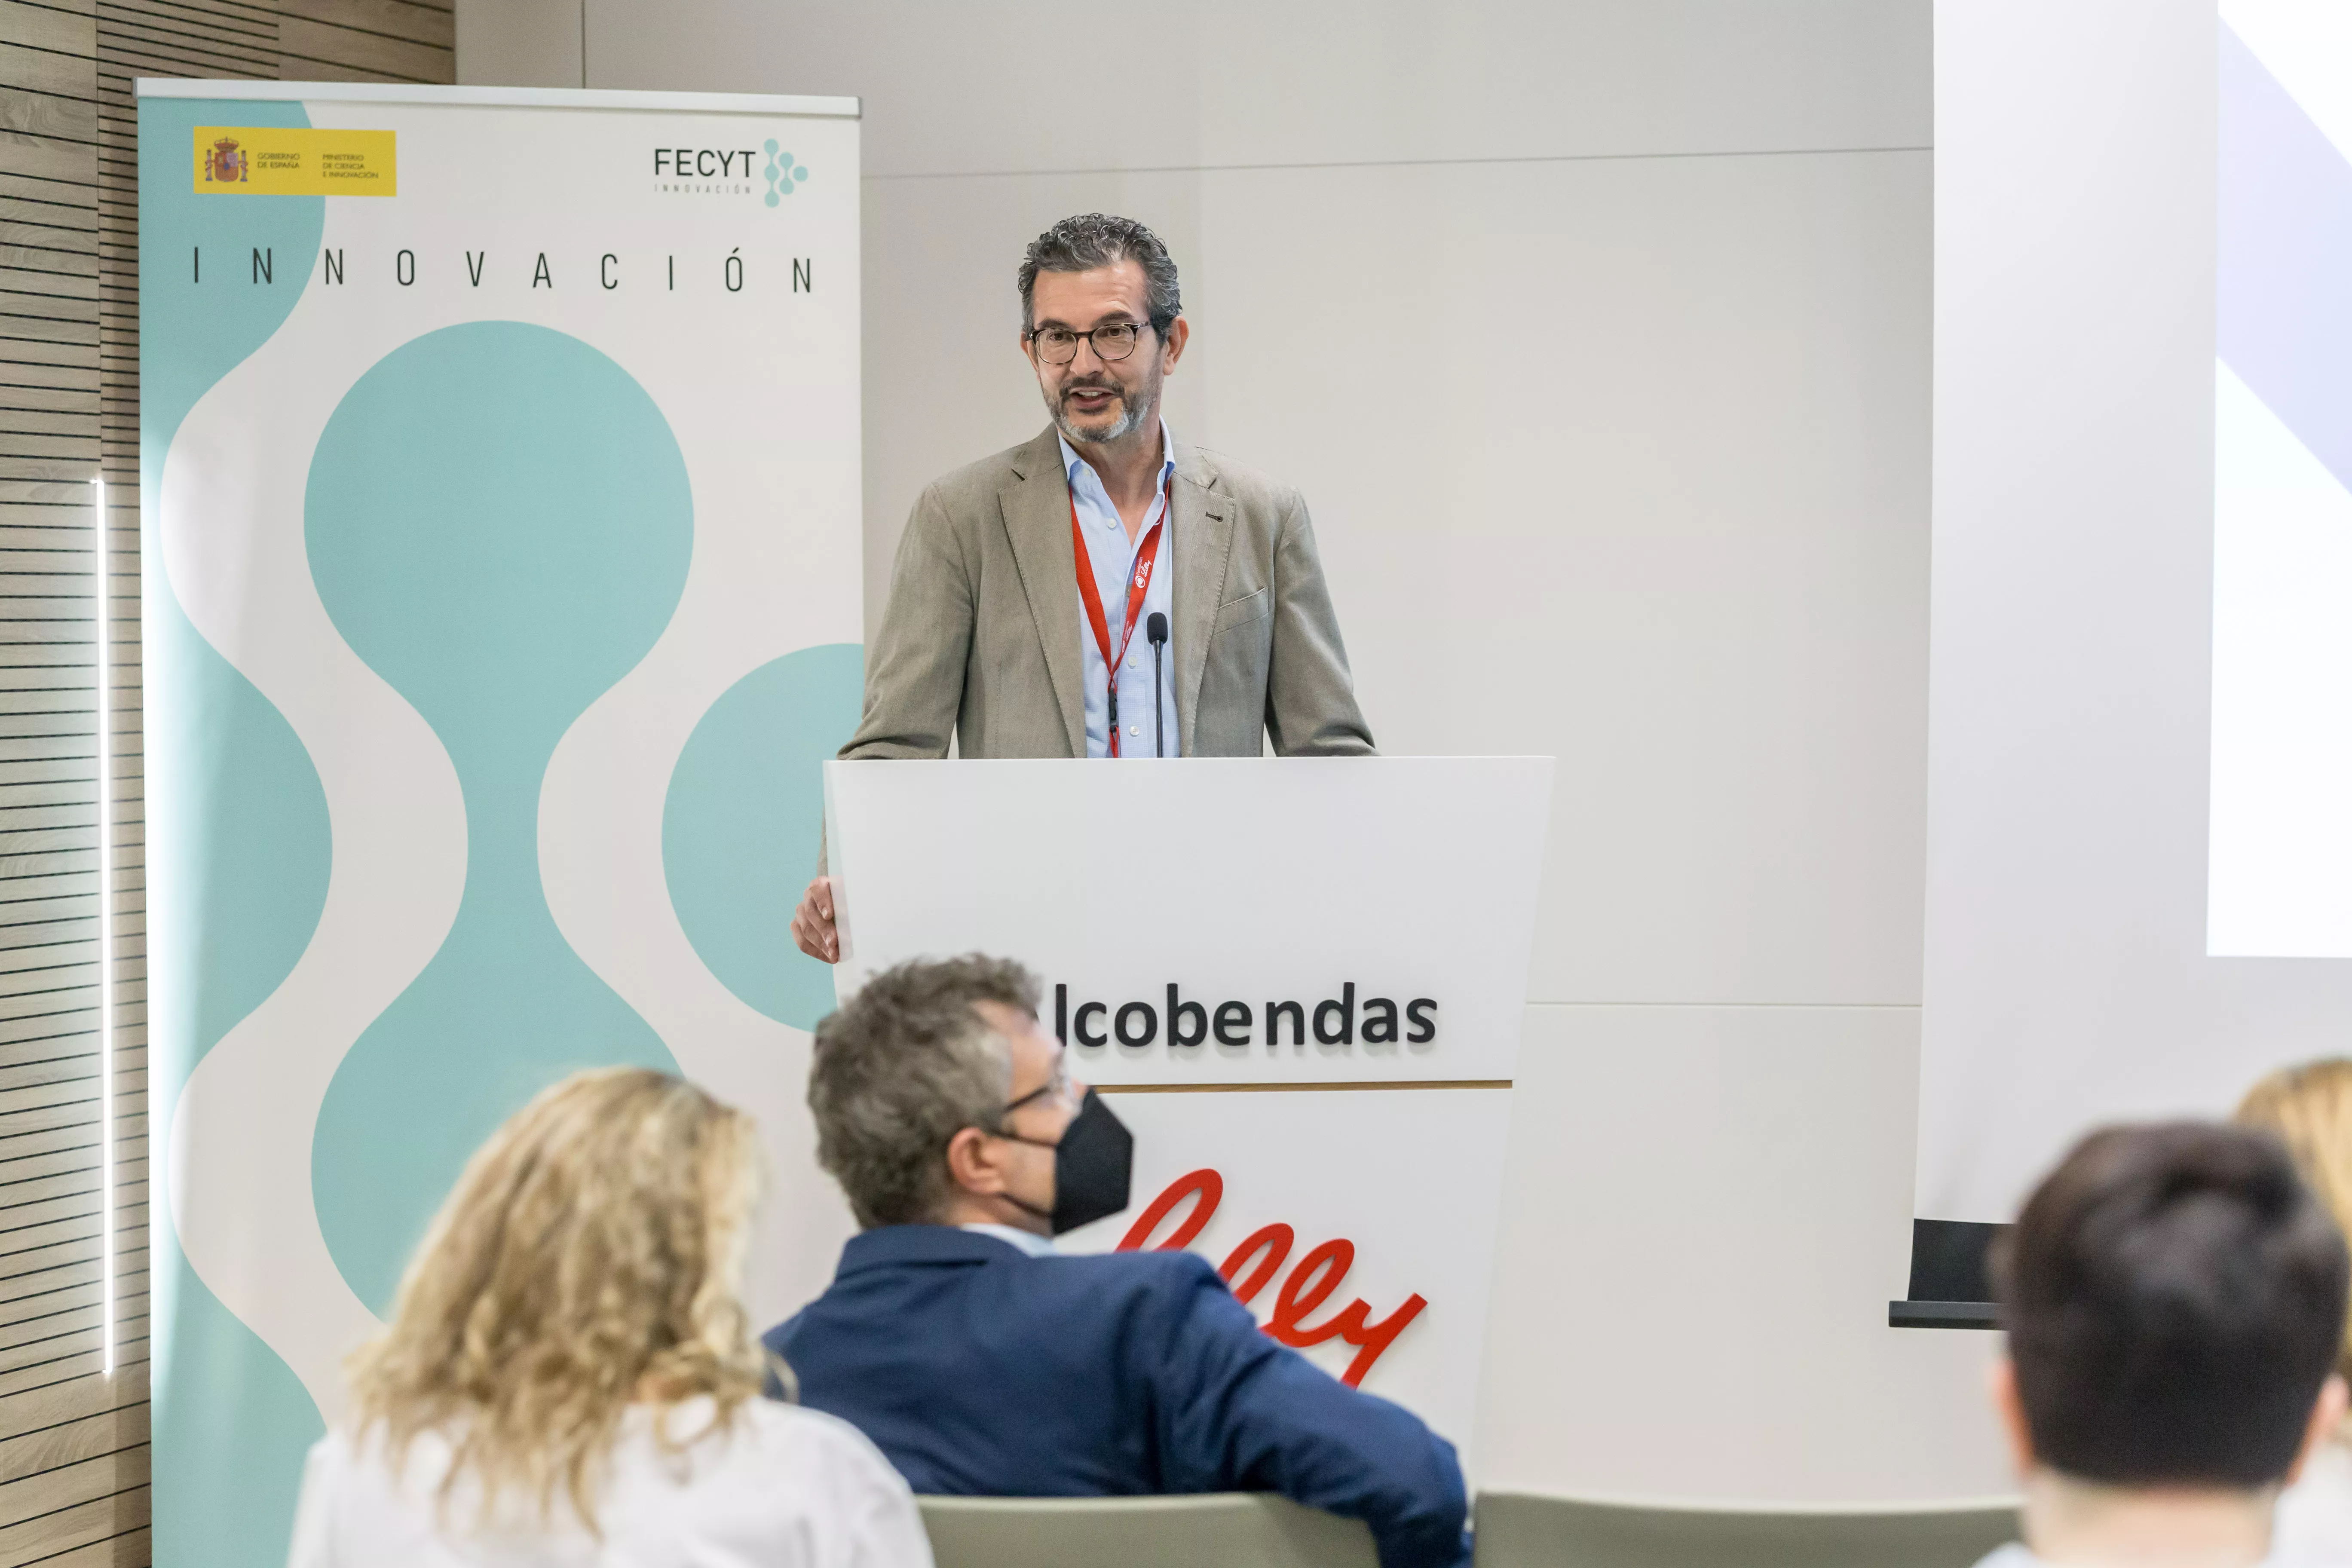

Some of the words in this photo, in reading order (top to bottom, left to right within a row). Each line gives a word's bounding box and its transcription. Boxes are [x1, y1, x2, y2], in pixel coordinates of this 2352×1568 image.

[655, 149, 756, 178] FECYT
[654, 183, 750, 194] INNOVACIÓN
[193, 246, 812, 293] INNOVACIÓN
[1055, 982, 1438, 1048] lcobendas
